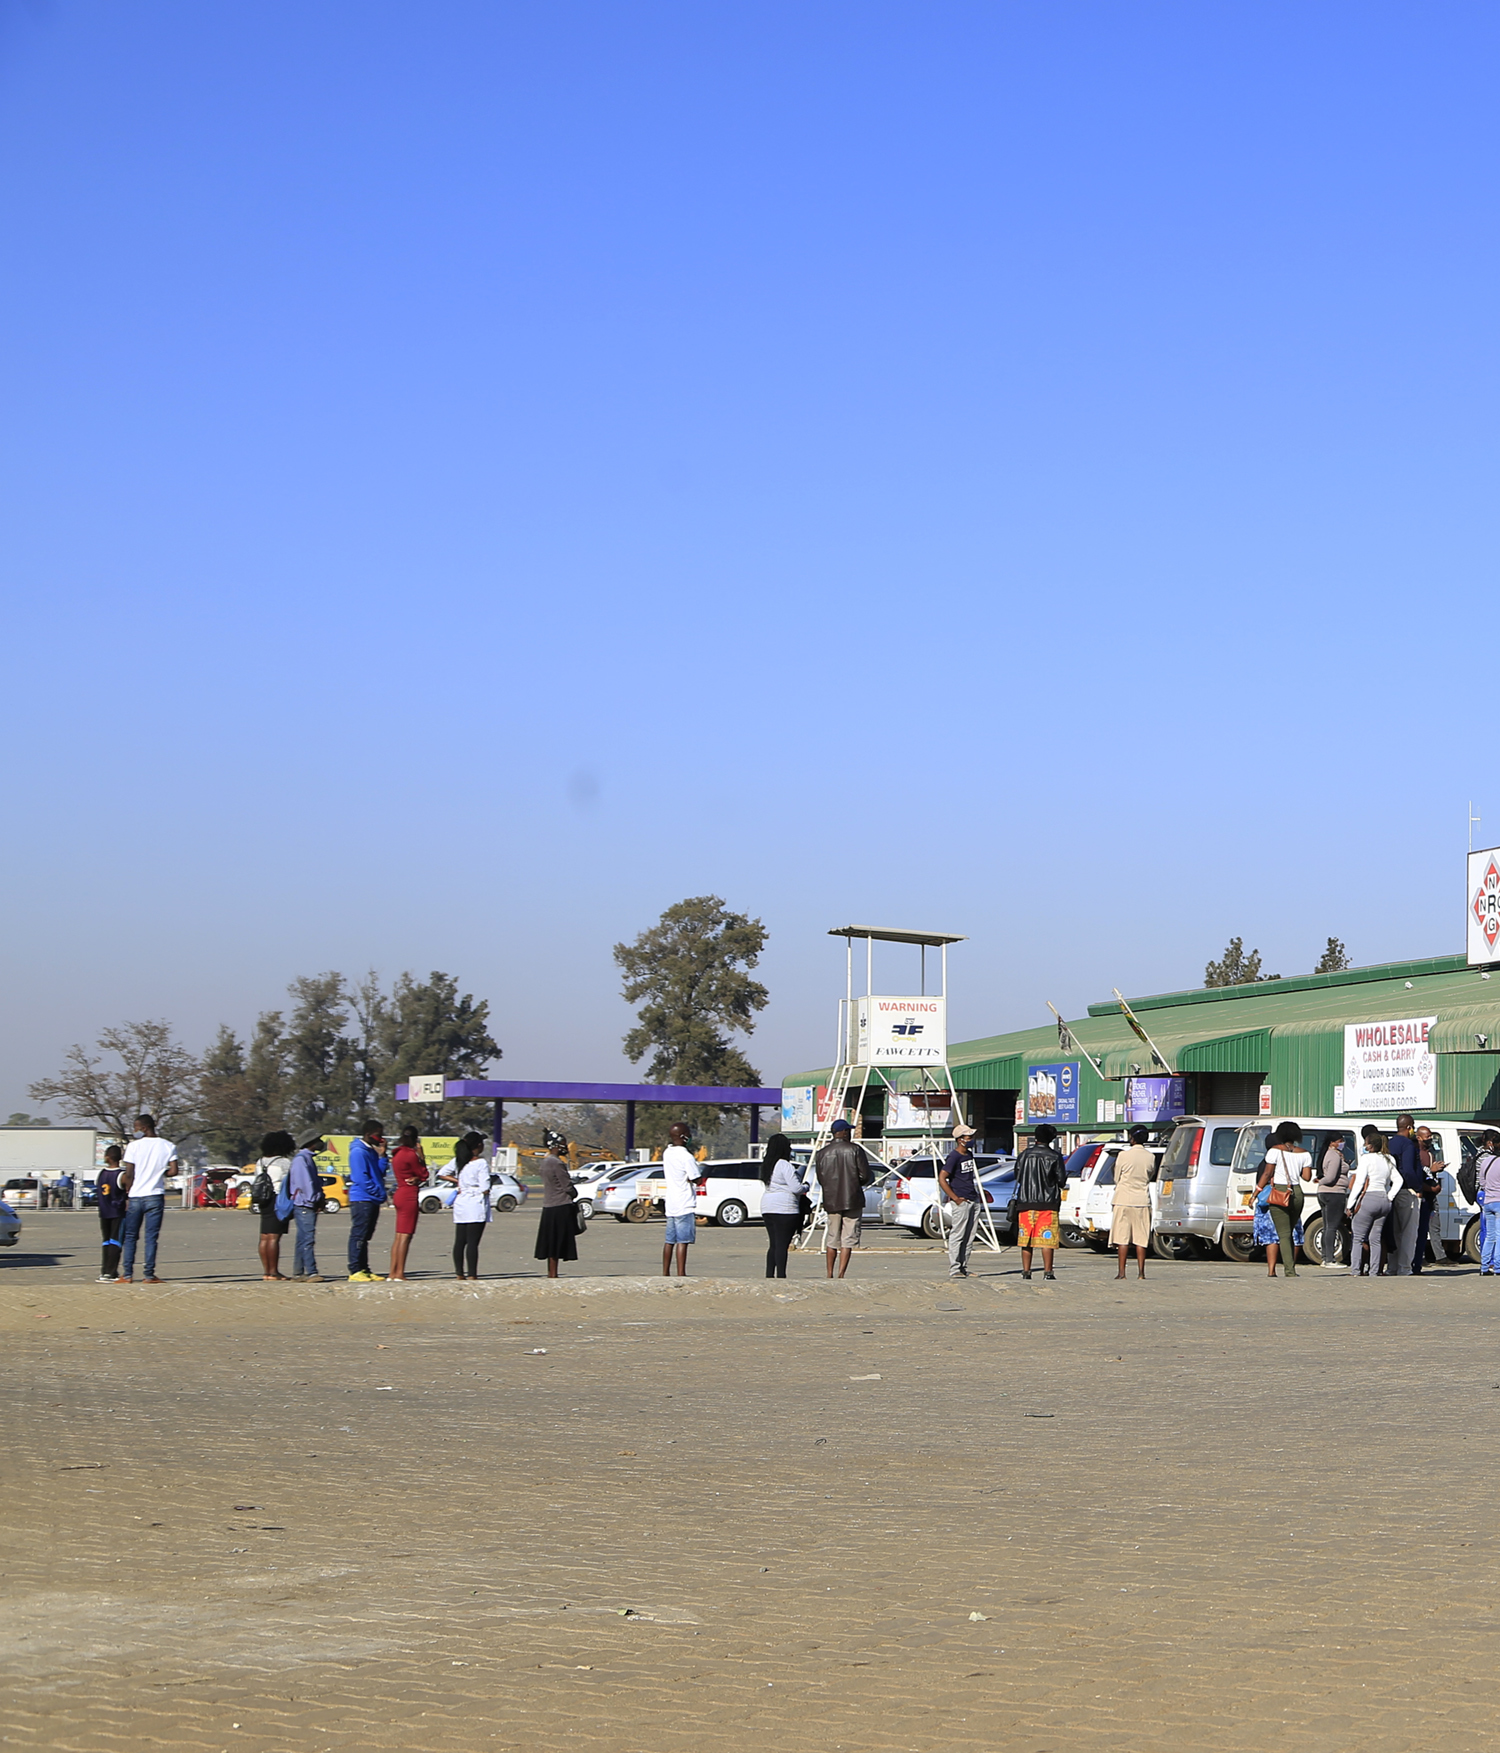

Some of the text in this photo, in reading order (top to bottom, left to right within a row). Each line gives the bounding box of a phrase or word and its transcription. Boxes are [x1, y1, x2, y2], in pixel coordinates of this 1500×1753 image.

[879, 1002, 937, 1012] WARNING
[1355, 1022, 1429, 1048] WHOLESALE
[875, 1047, 940, 1056] FAWCETTS
[1363, 1048, 1416, 1063] CASH & CARRY
[1363, 1068, 1384, 1079] LIQUOR
[1392, 1067, 1414, 1077] DRINKS
[1372, 1082, 1405, 1093] GROCERIES
[1360, 1096, 1417, 1108] HOUSEHOLD GOODS
[101, 1184, 110, 1195] 3
